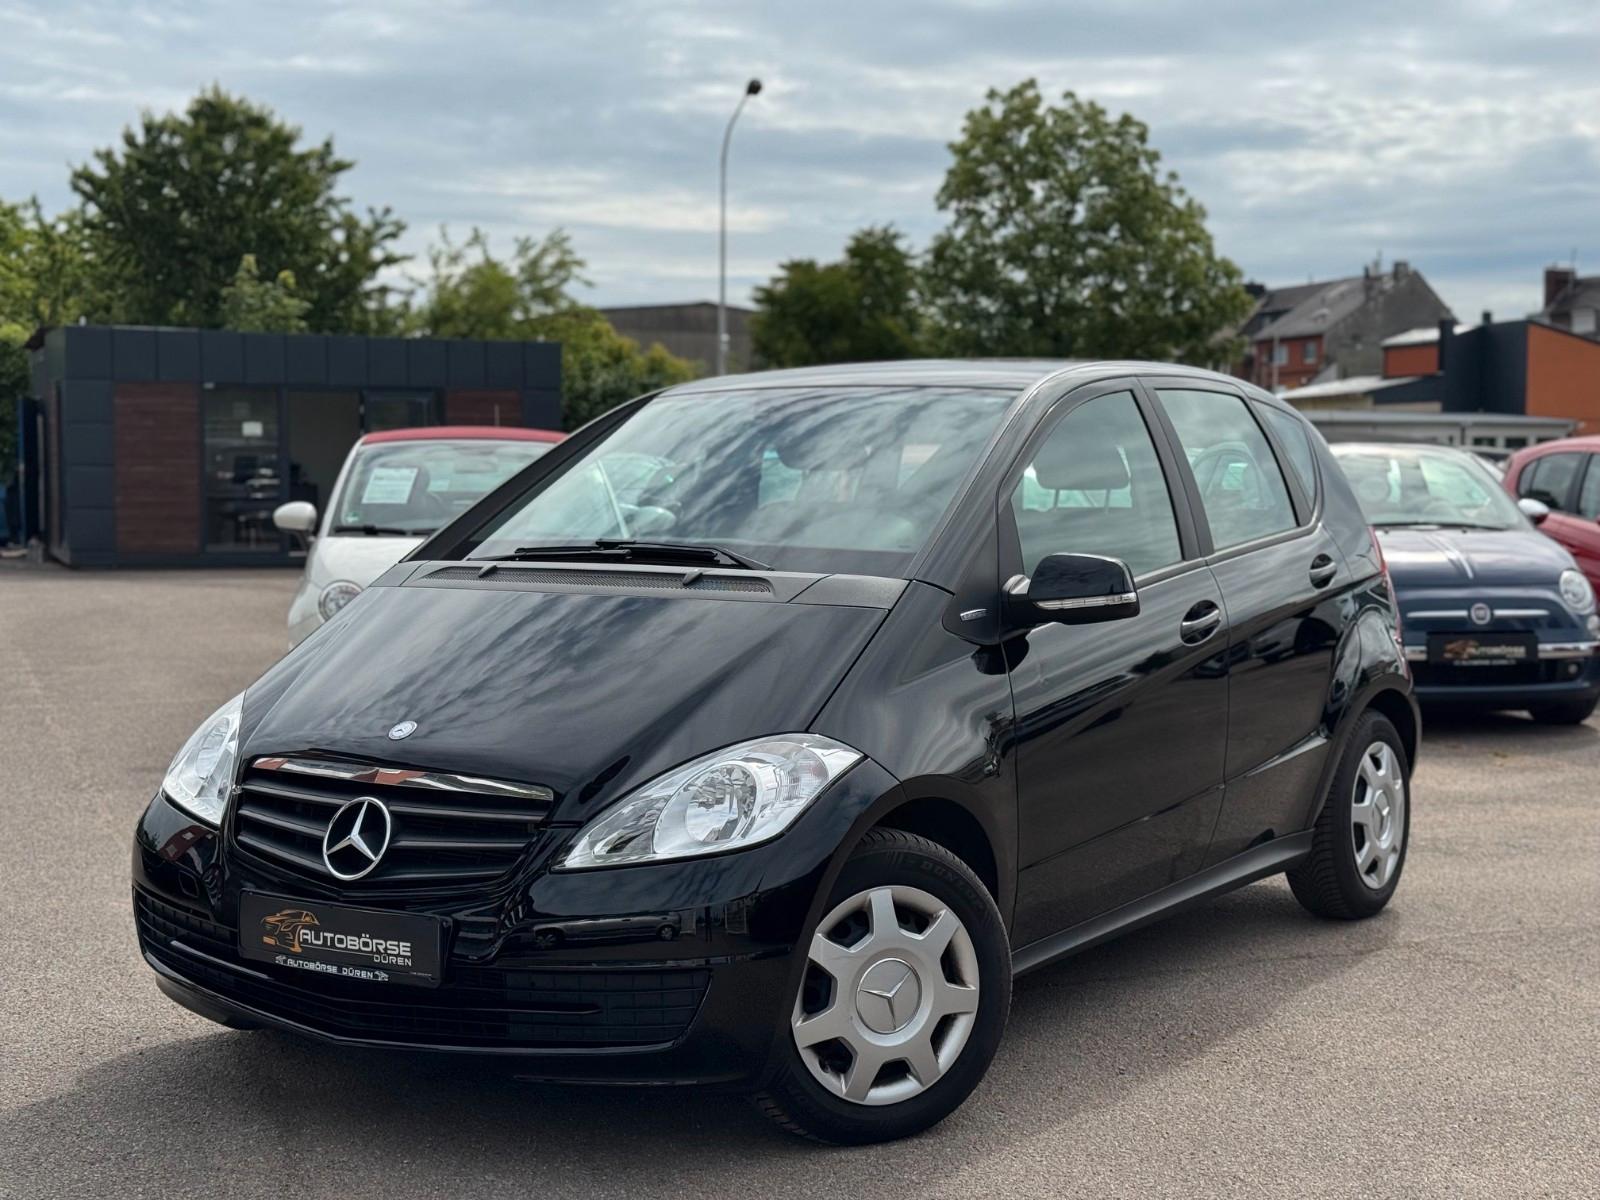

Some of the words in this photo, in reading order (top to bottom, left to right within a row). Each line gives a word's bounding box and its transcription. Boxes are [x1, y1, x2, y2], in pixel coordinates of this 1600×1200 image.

[300, 929, 412, 957] AUTOBÖRSE
[287, 958, 338, 973] AUTOBÖRSE
[342, 967, 374, 980] DÜREN
[373, 954, 412, 967] DÜREN
